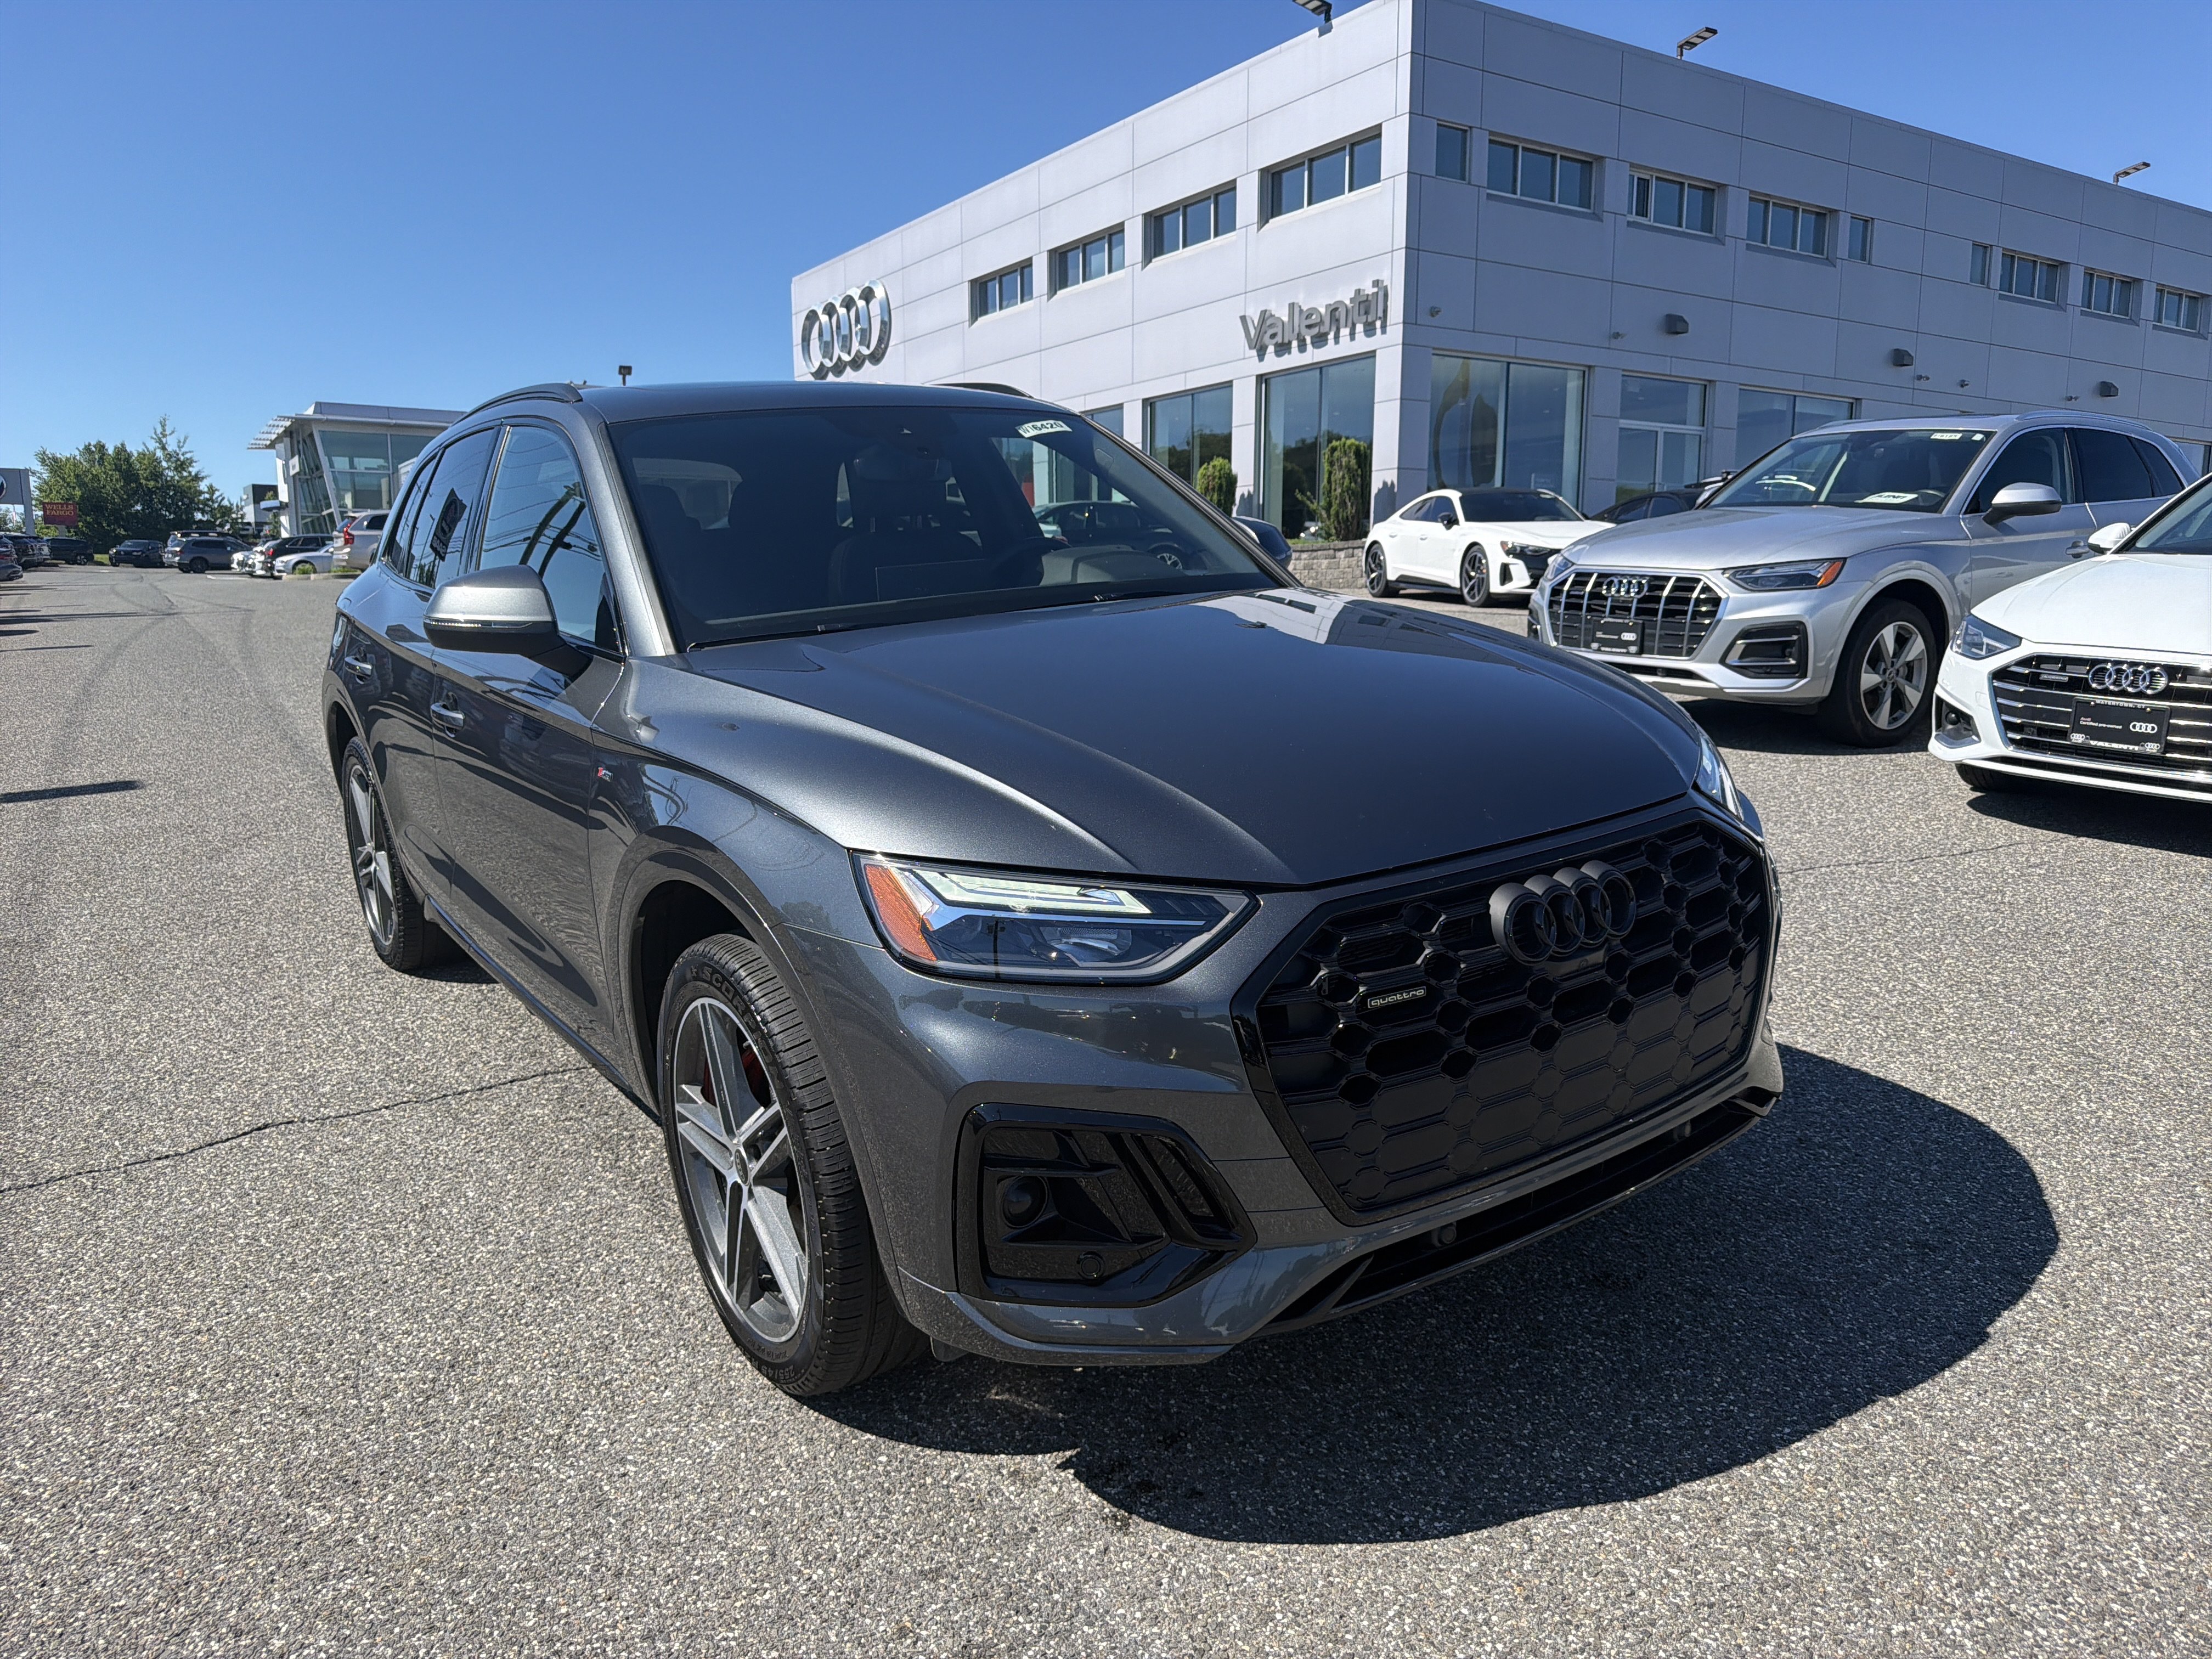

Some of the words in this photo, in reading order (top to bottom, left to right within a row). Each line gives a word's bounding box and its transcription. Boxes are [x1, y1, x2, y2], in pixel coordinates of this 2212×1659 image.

[1239, 279, 1389, 350] Valenti
[2096, 699, 2135, 708] WATERTOWN,
[2089, 741, 2138, 751] VALENTI
[1372, 989, 1425, 1006] quattro
